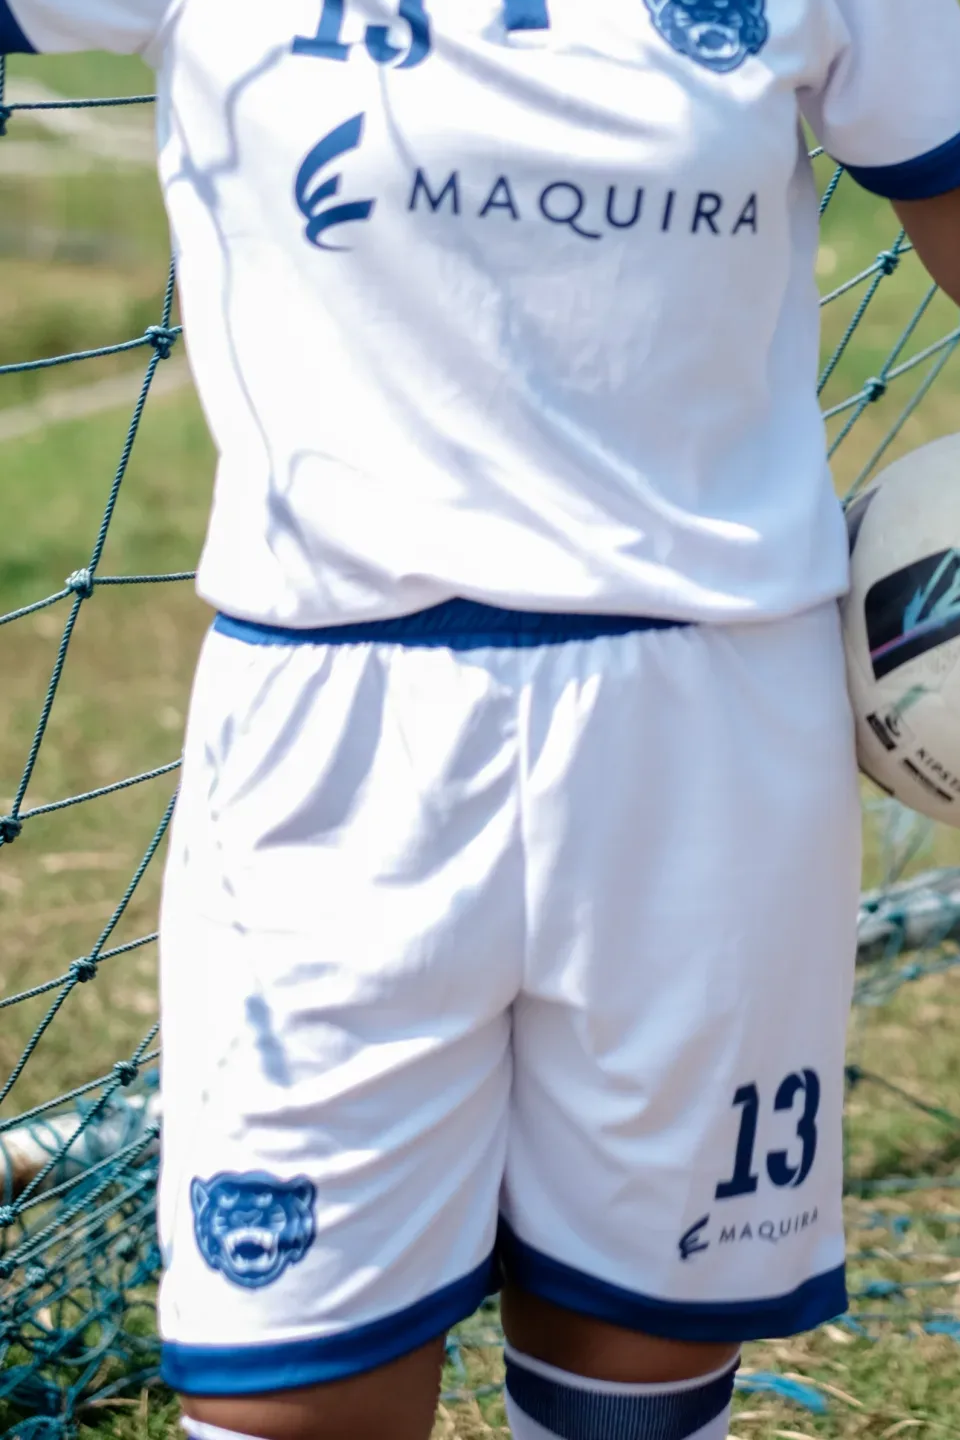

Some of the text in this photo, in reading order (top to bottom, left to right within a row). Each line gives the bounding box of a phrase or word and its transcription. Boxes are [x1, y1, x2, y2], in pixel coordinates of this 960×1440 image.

[407, 167, 759, 240] MAQUIRA
[714, 1066, 821, 1200] 13
[718, 1207, 819, 1245] MAQUIRA
